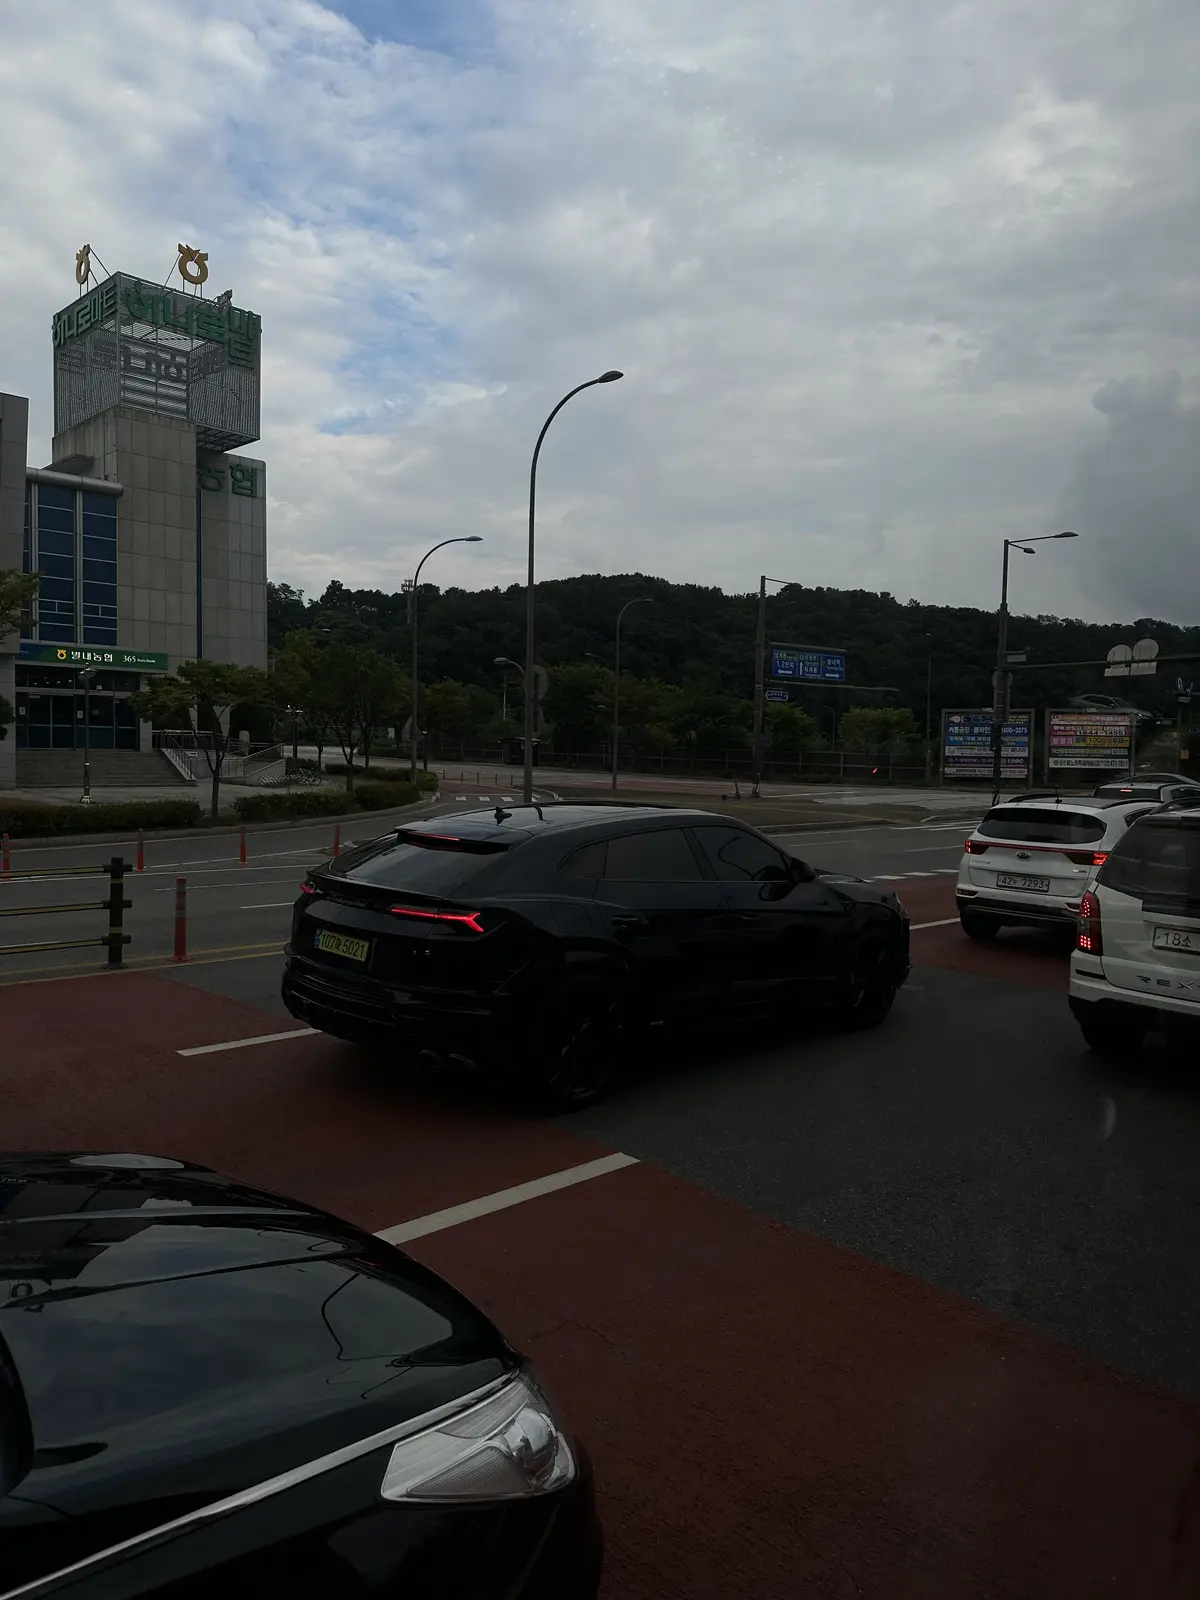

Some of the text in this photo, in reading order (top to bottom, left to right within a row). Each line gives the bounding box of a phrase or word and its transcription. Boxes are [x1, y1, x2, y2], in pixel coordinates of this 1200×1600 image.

[51, 283, 117, 347] 하나로마트
[71, 650, 114, 663] 별내농협
[122, 655, 136, 664] 365
[1021, 878, 1044, 889] 7293
[1164, 931, 1192, 947] 18소
[342, 939, 365, 958] 5021
